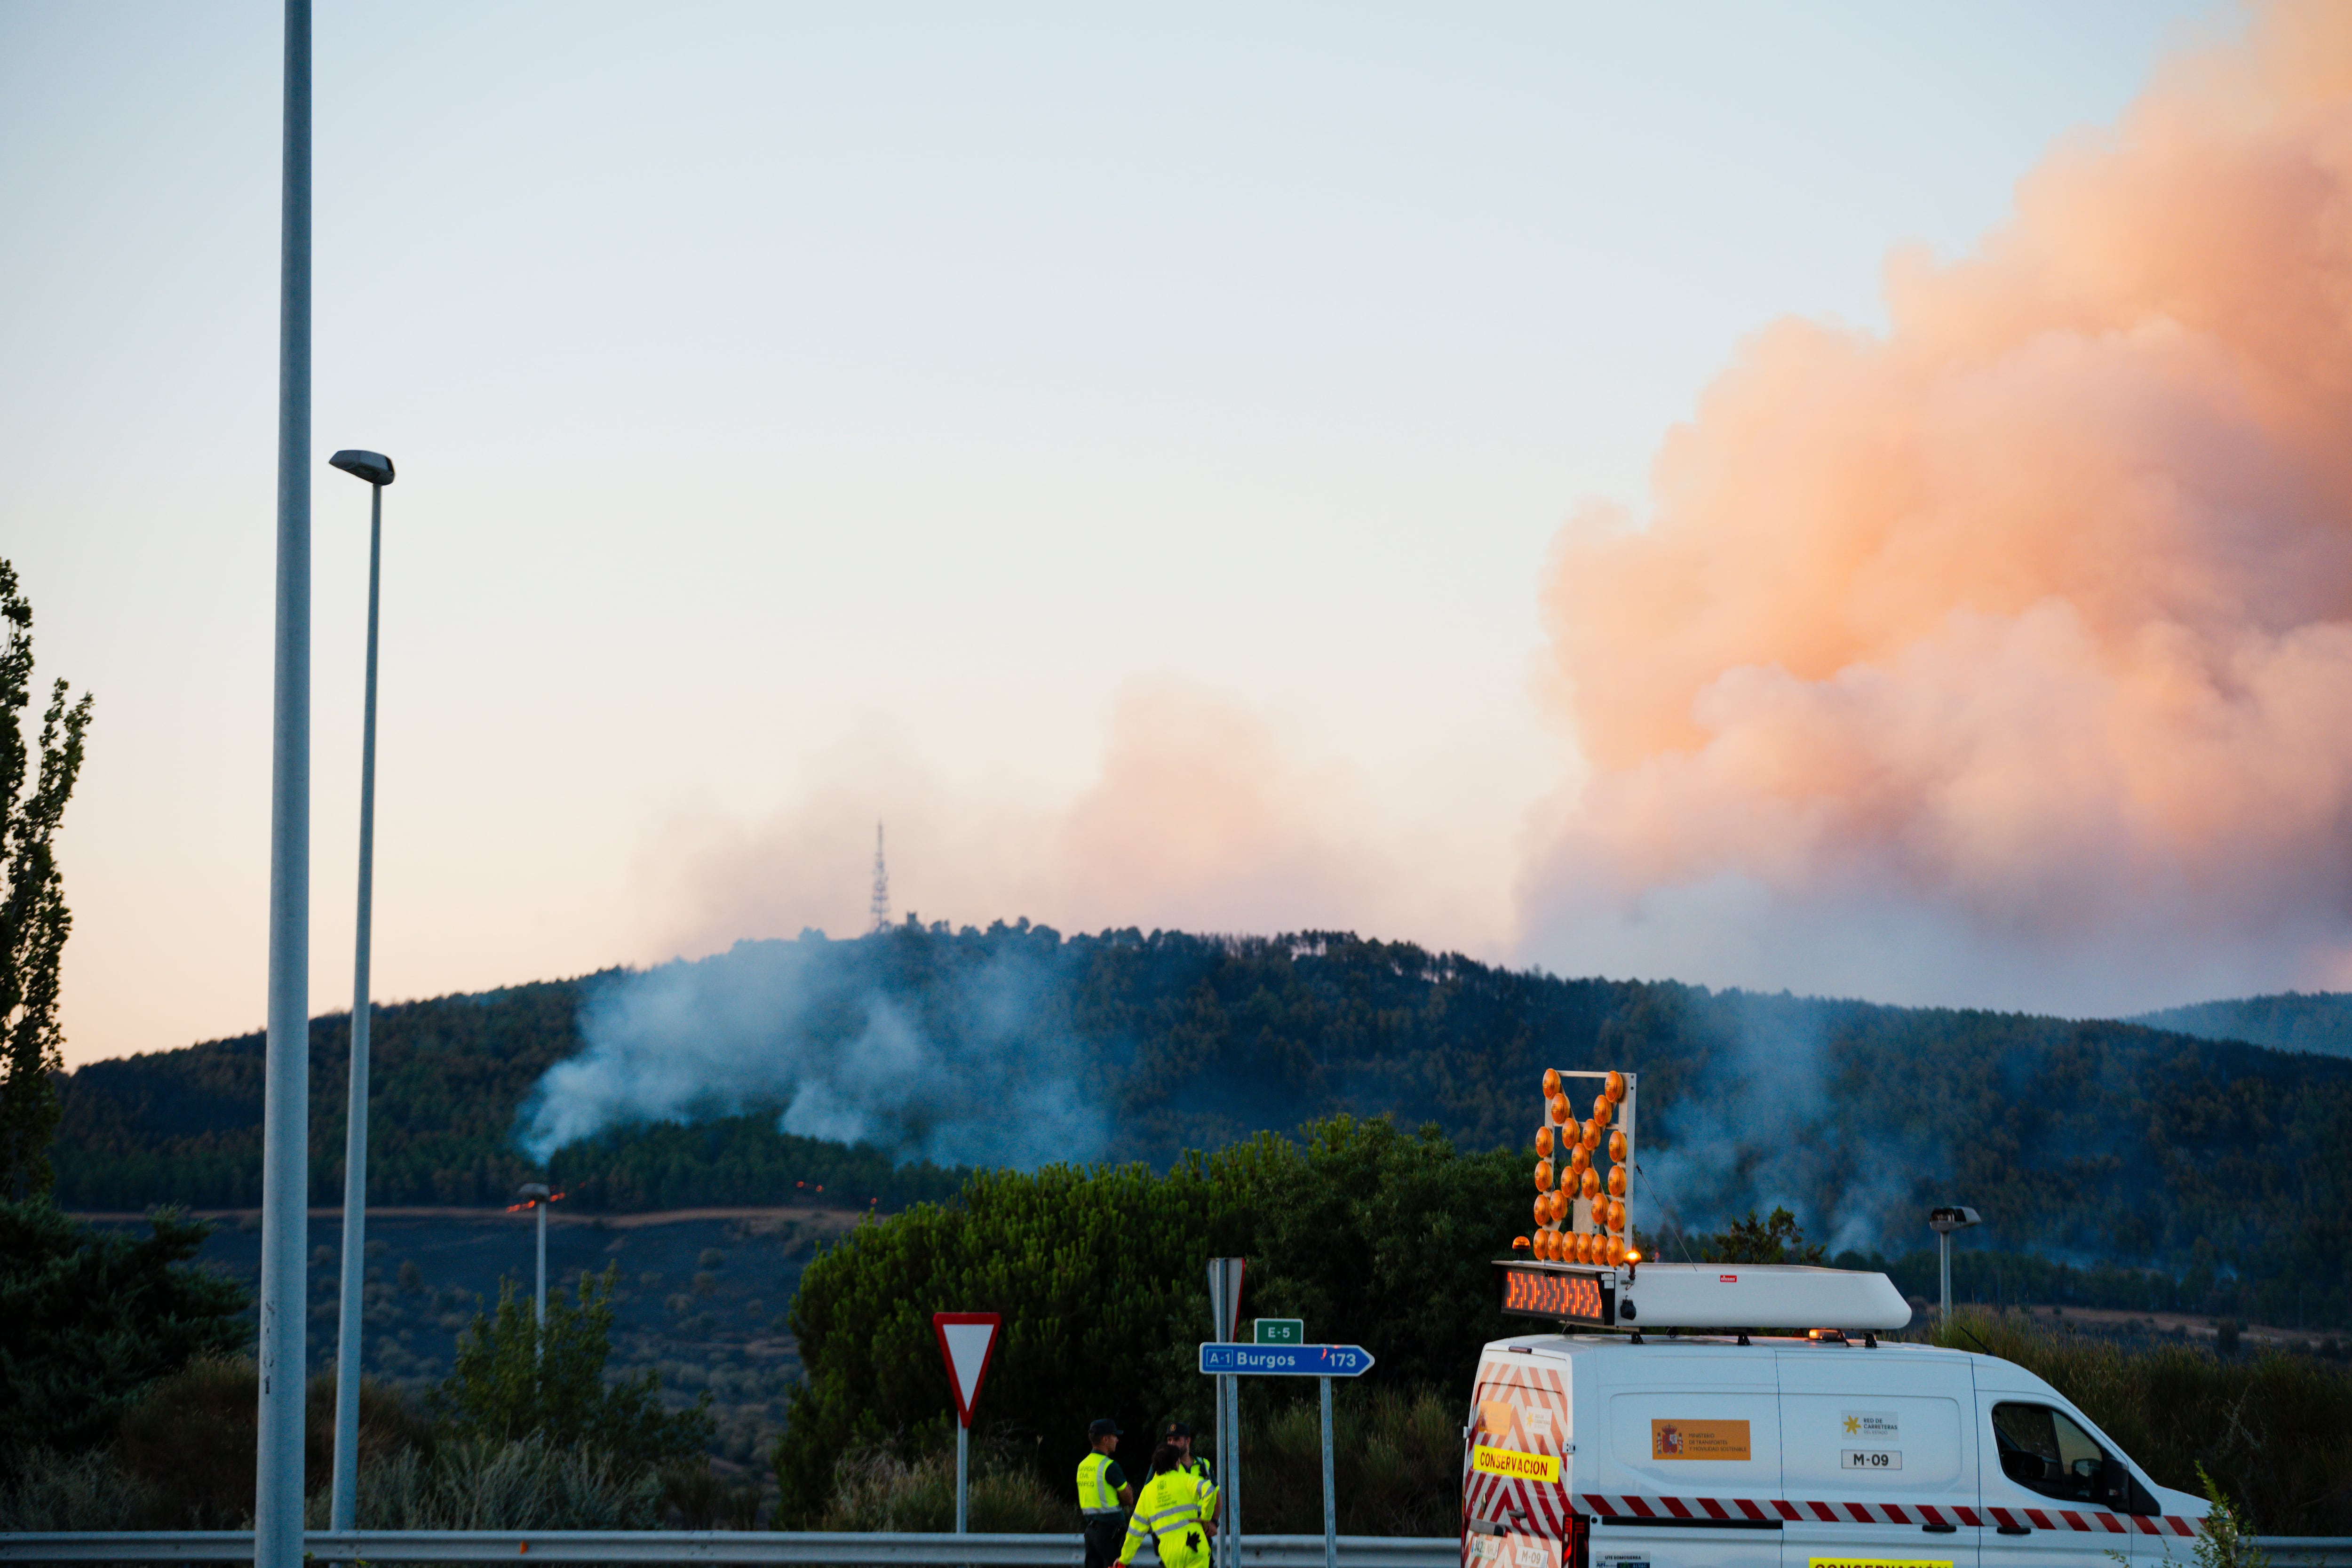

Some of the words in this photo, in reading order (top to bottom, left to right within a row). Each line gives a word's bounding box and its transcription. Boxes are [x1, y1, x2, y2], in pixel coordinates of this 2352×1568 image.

[1268, 1327, 1290, 1338] E-5
[1210, 1353, 1230, 1364] A-1
[1237, 1352, 1295, 1368] Burgos
[1329, 1353, 1356, 1367] 173
[1480, 1451, 1548, 1476] CONSERVACIÓN
[1853, 1453, 1889, 1466] M-09
[1521, 1550, 1541, 1564] M-09
